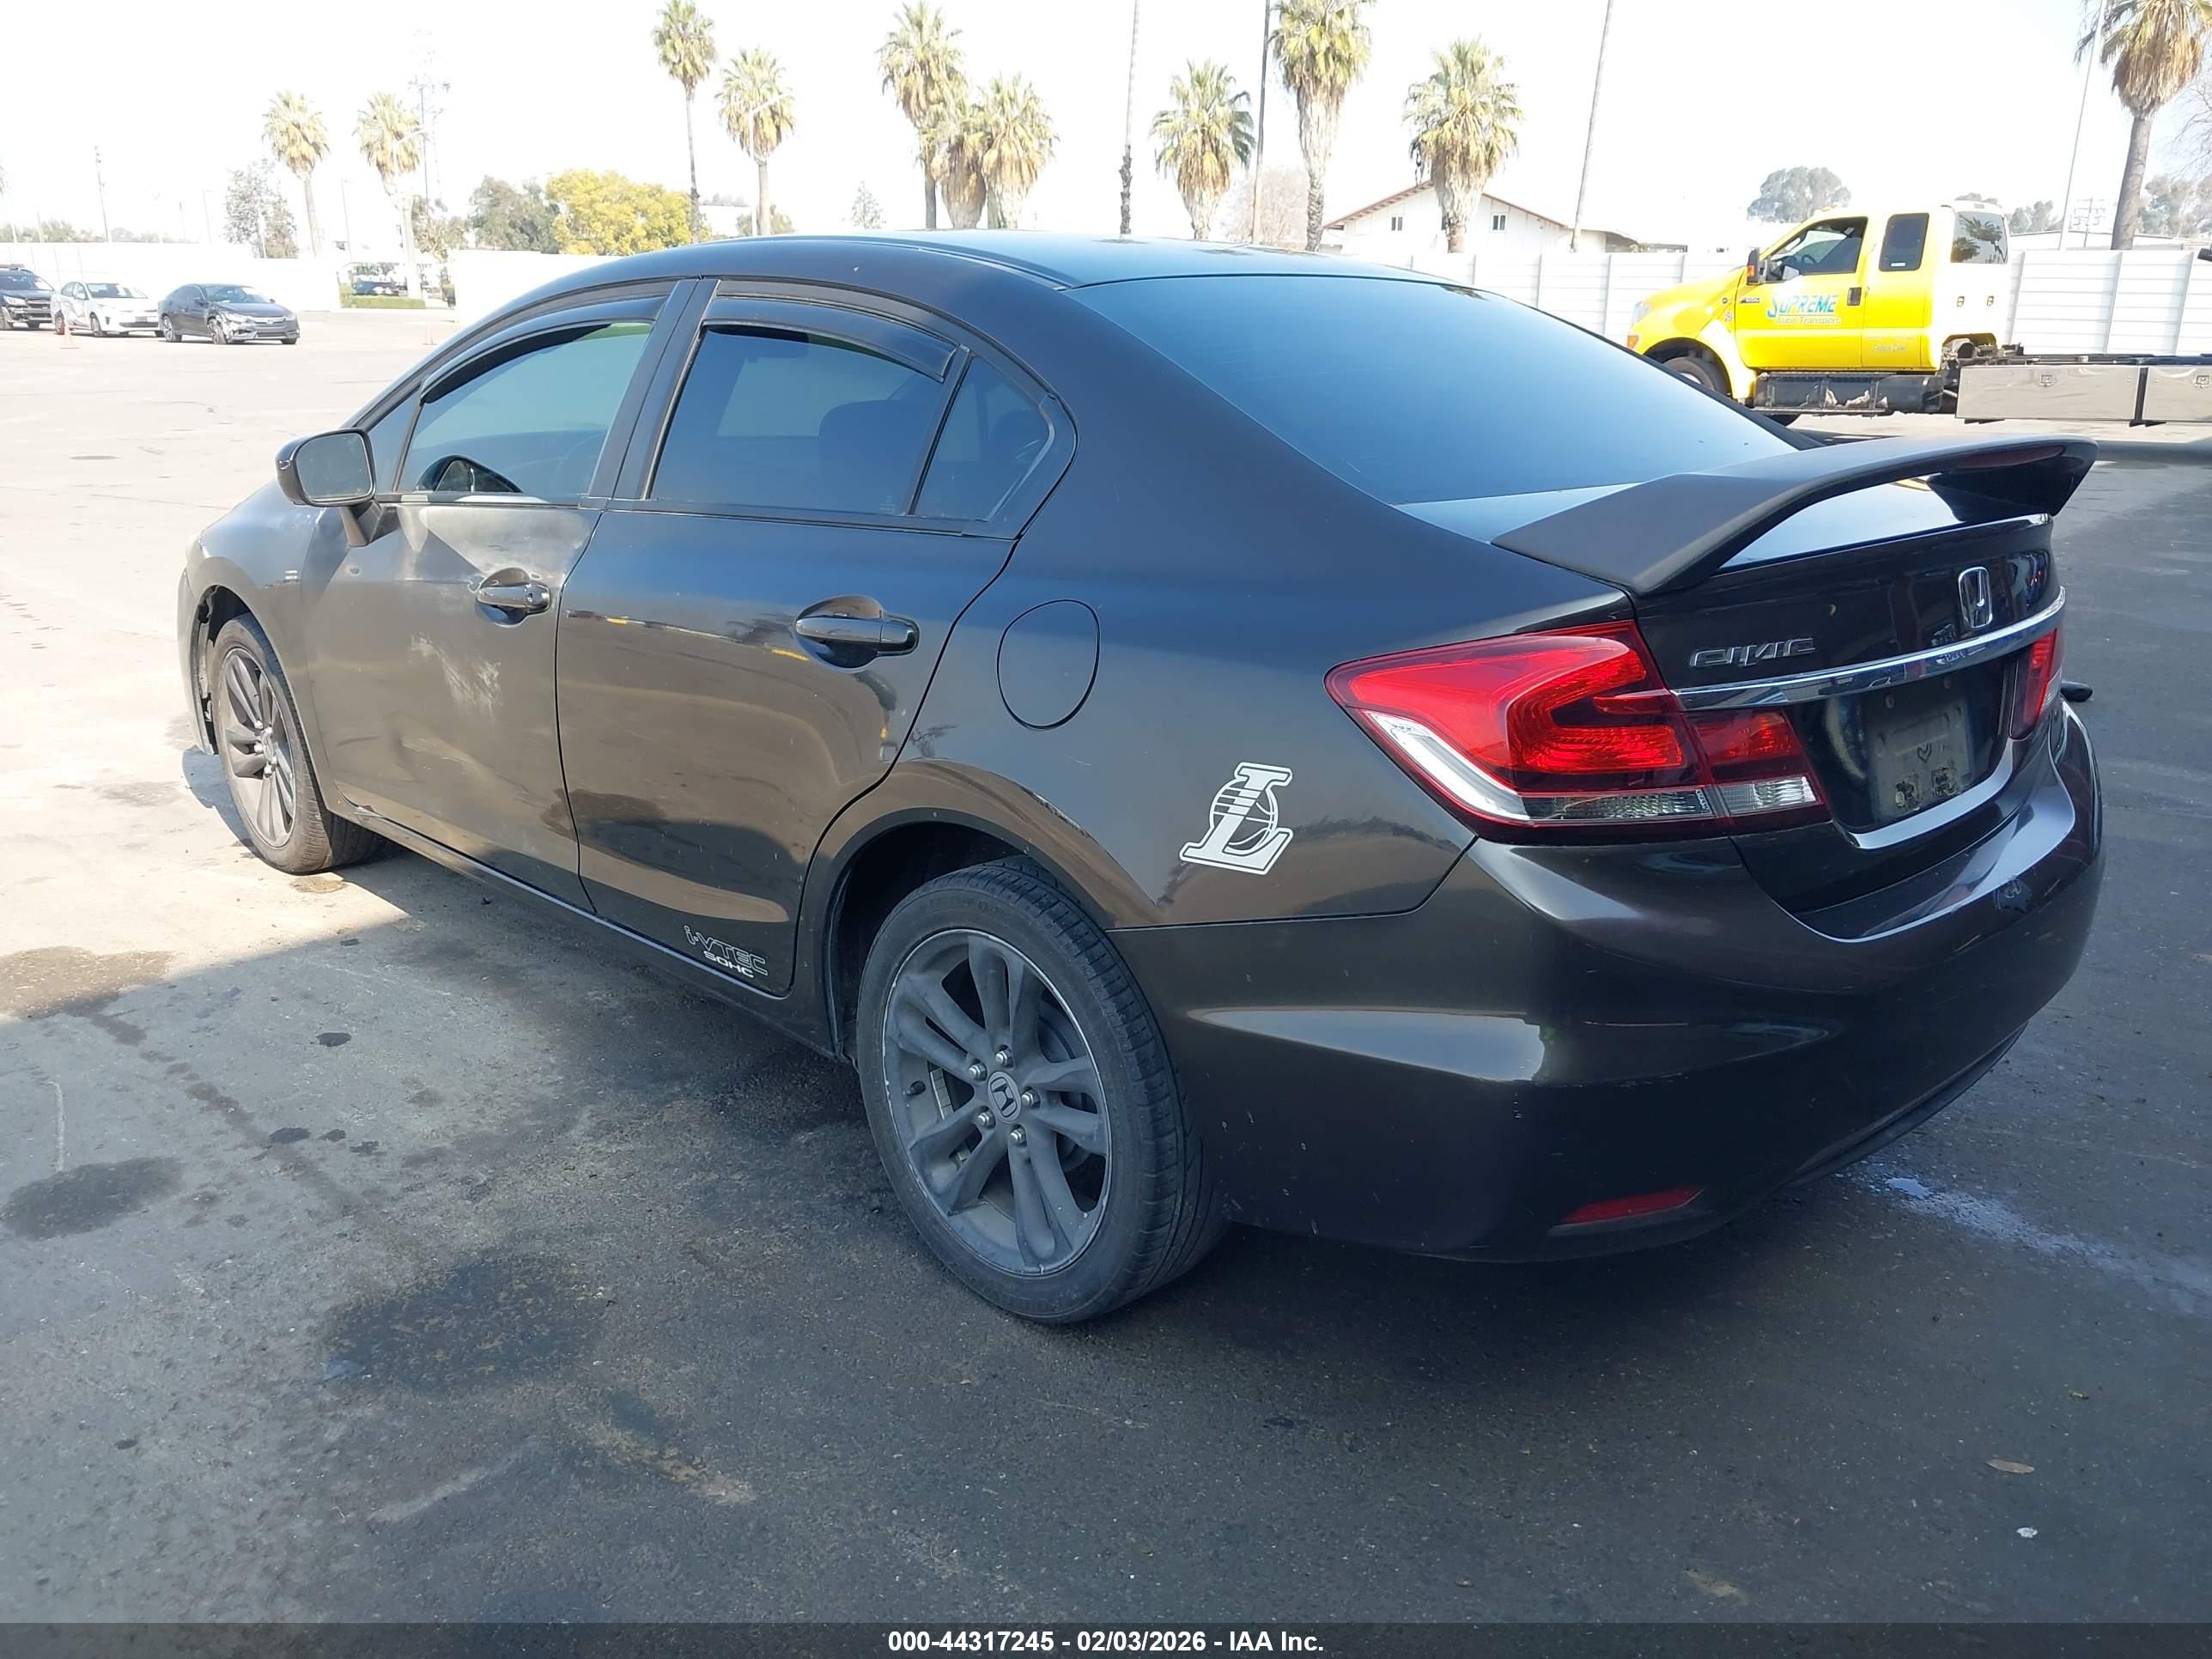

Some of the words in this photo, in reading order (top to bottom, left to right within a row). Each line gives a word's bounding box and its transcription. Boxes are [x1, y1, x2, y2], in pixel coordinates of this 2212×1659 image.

[1766, 290, 1839, 318] SUPREME
[1689, 637, 1816, 666] CIVIC
[703, 950, 755, 978] SOHC
